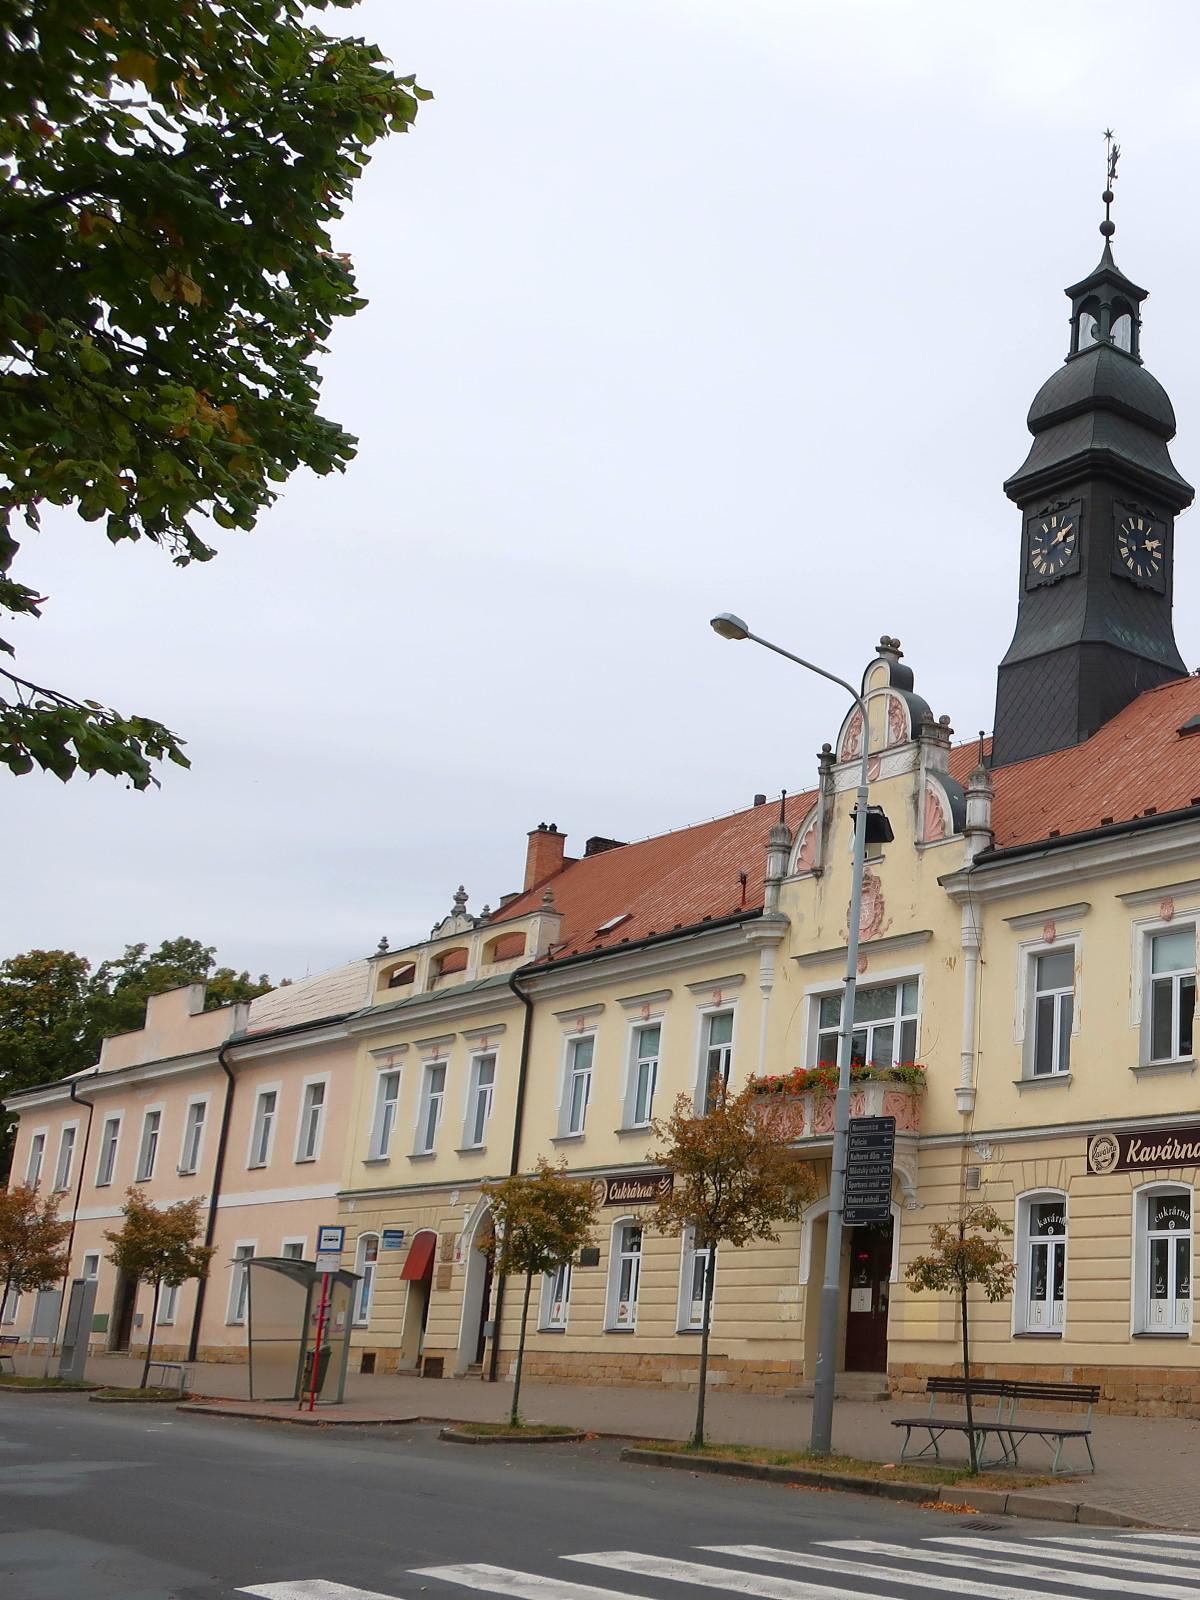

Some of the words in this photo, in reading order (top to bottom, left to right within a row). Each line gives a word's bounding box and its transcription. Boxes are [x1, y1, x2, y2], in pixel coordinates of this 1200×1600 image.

[609, 1181, 653, 1200] Cukrárna
[846, 1210, 856, 1218] WC
[1154, 1205, 1190, 1223] cukrárna
